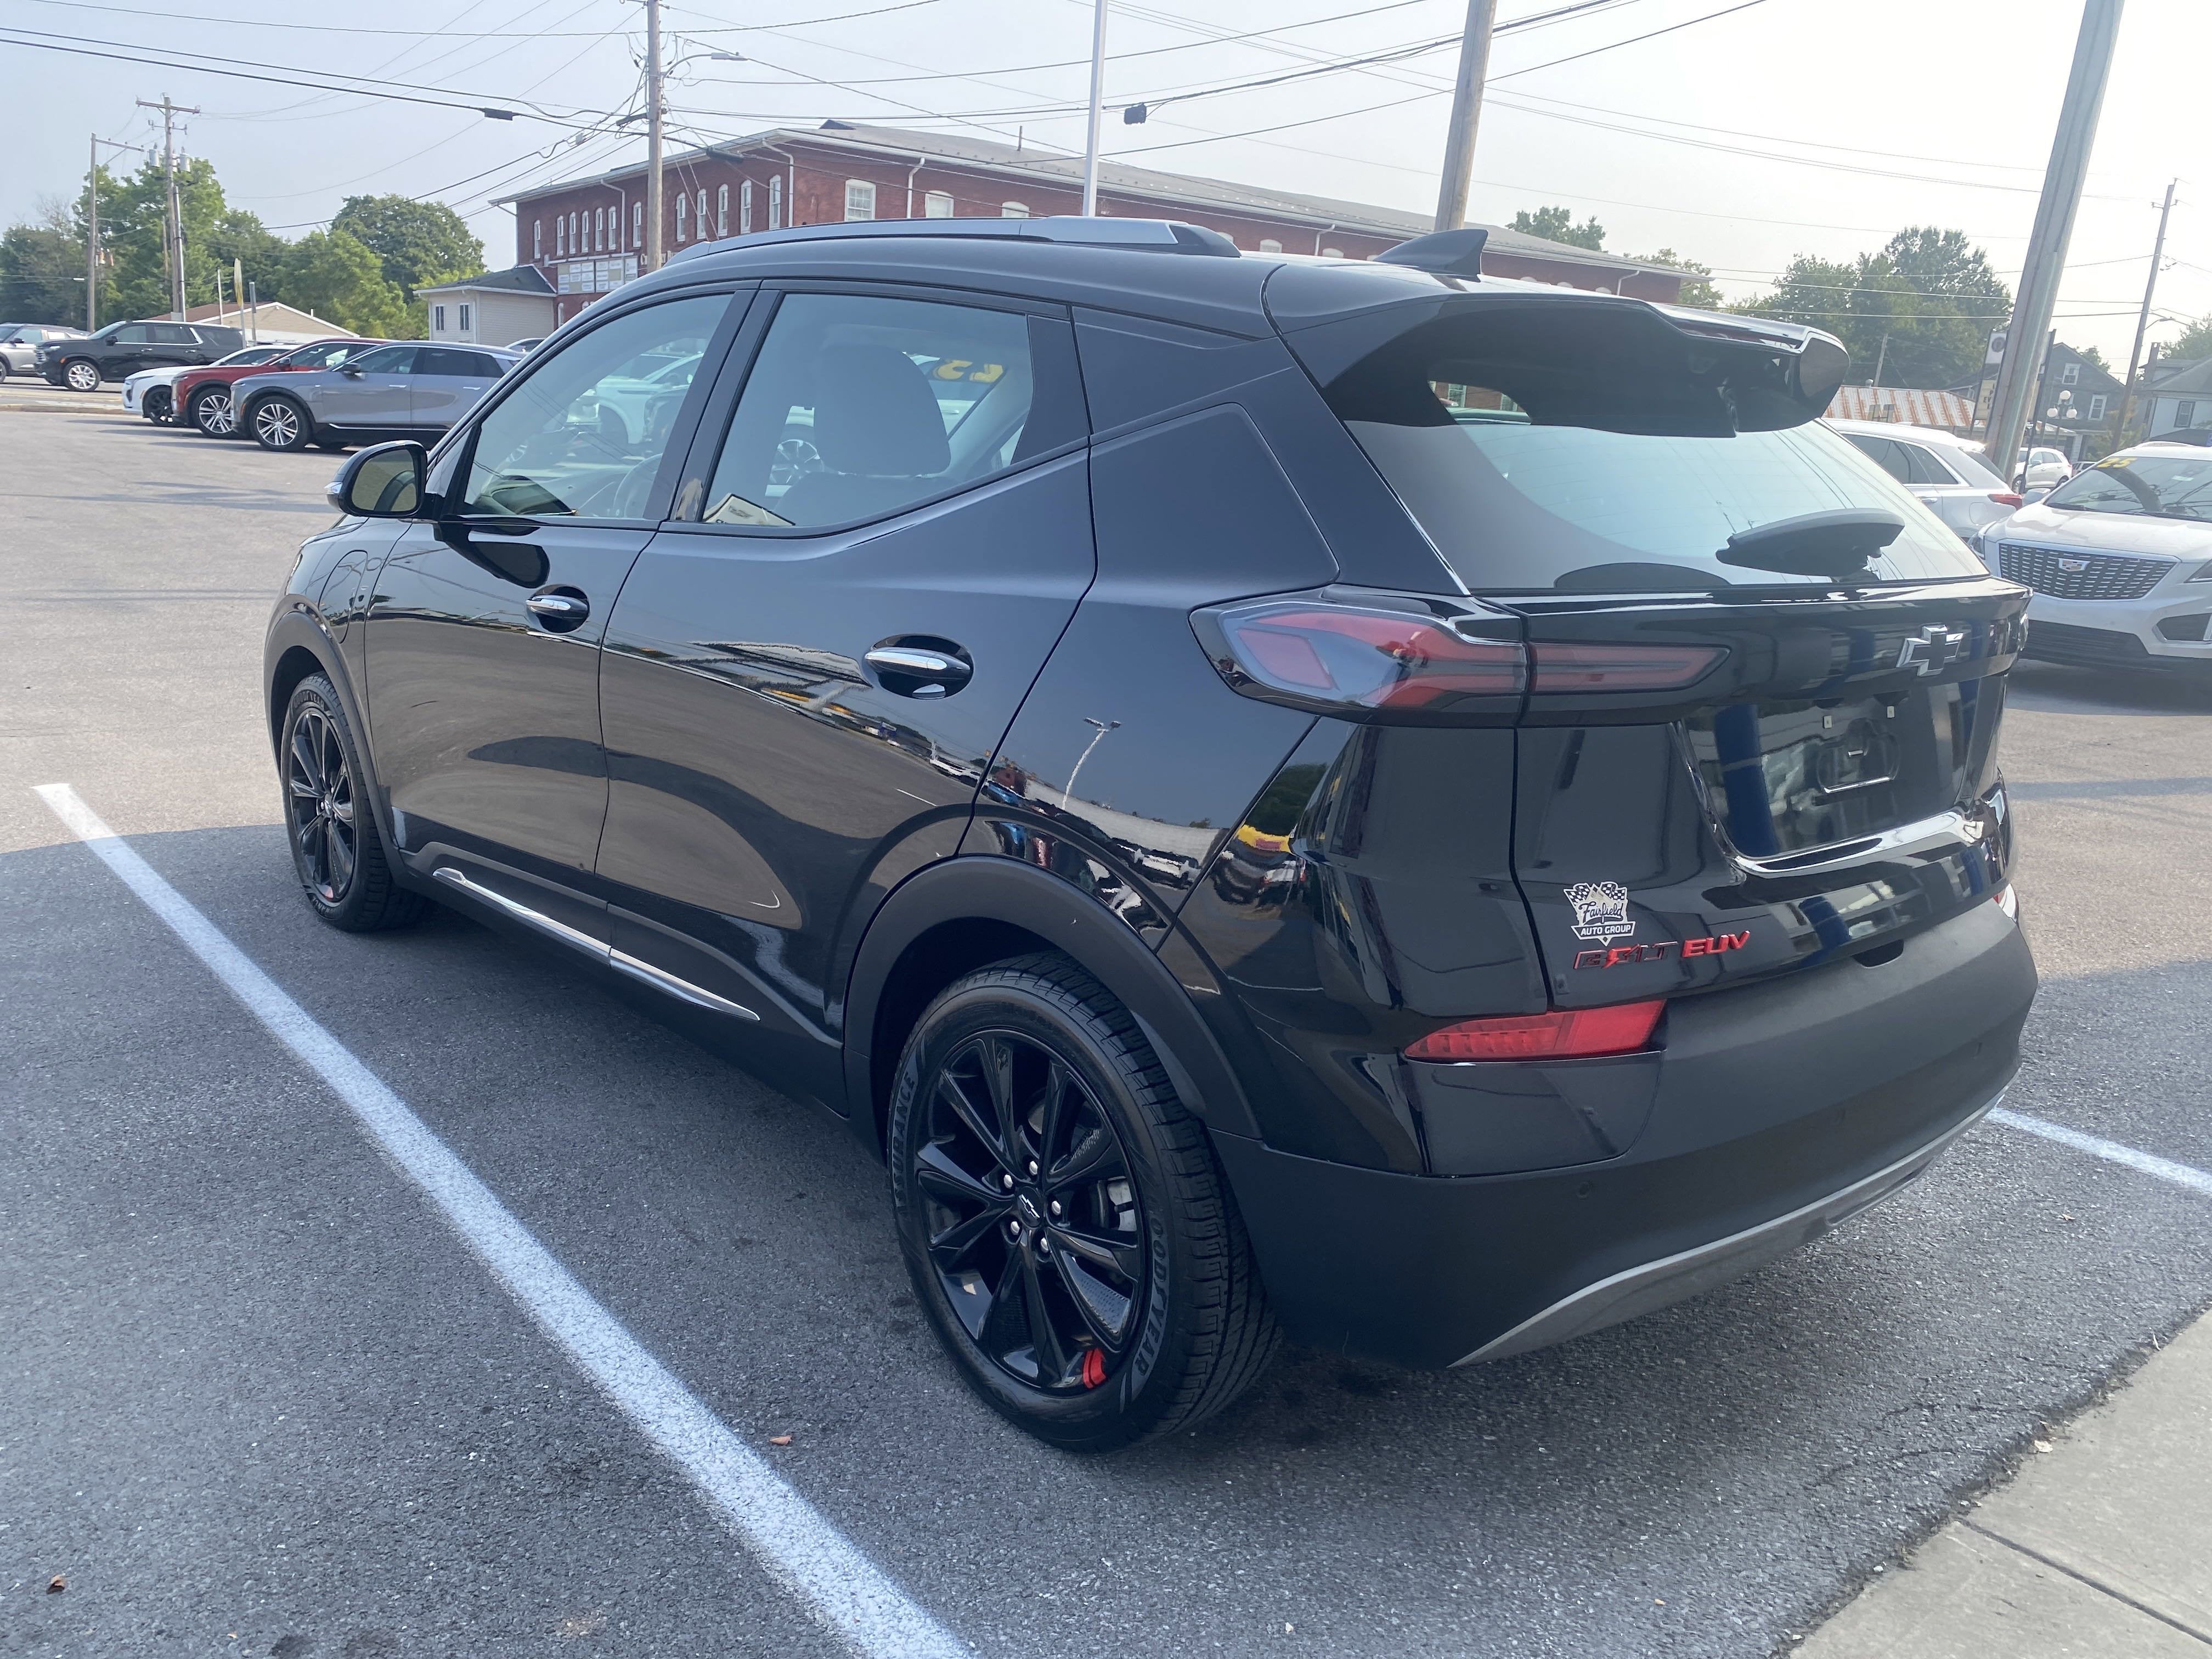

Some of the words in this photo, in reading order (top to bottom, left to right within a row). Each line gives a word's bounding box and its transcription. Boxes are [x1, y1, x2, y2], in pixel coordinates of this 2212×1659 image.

[1578, 901, 1624, 924] Fairfield
[1580, 927, 1603, 936] AUTO
[1604, 924, 1632, 934] GROUP
[1683, 930, 1750, 957] EUV
